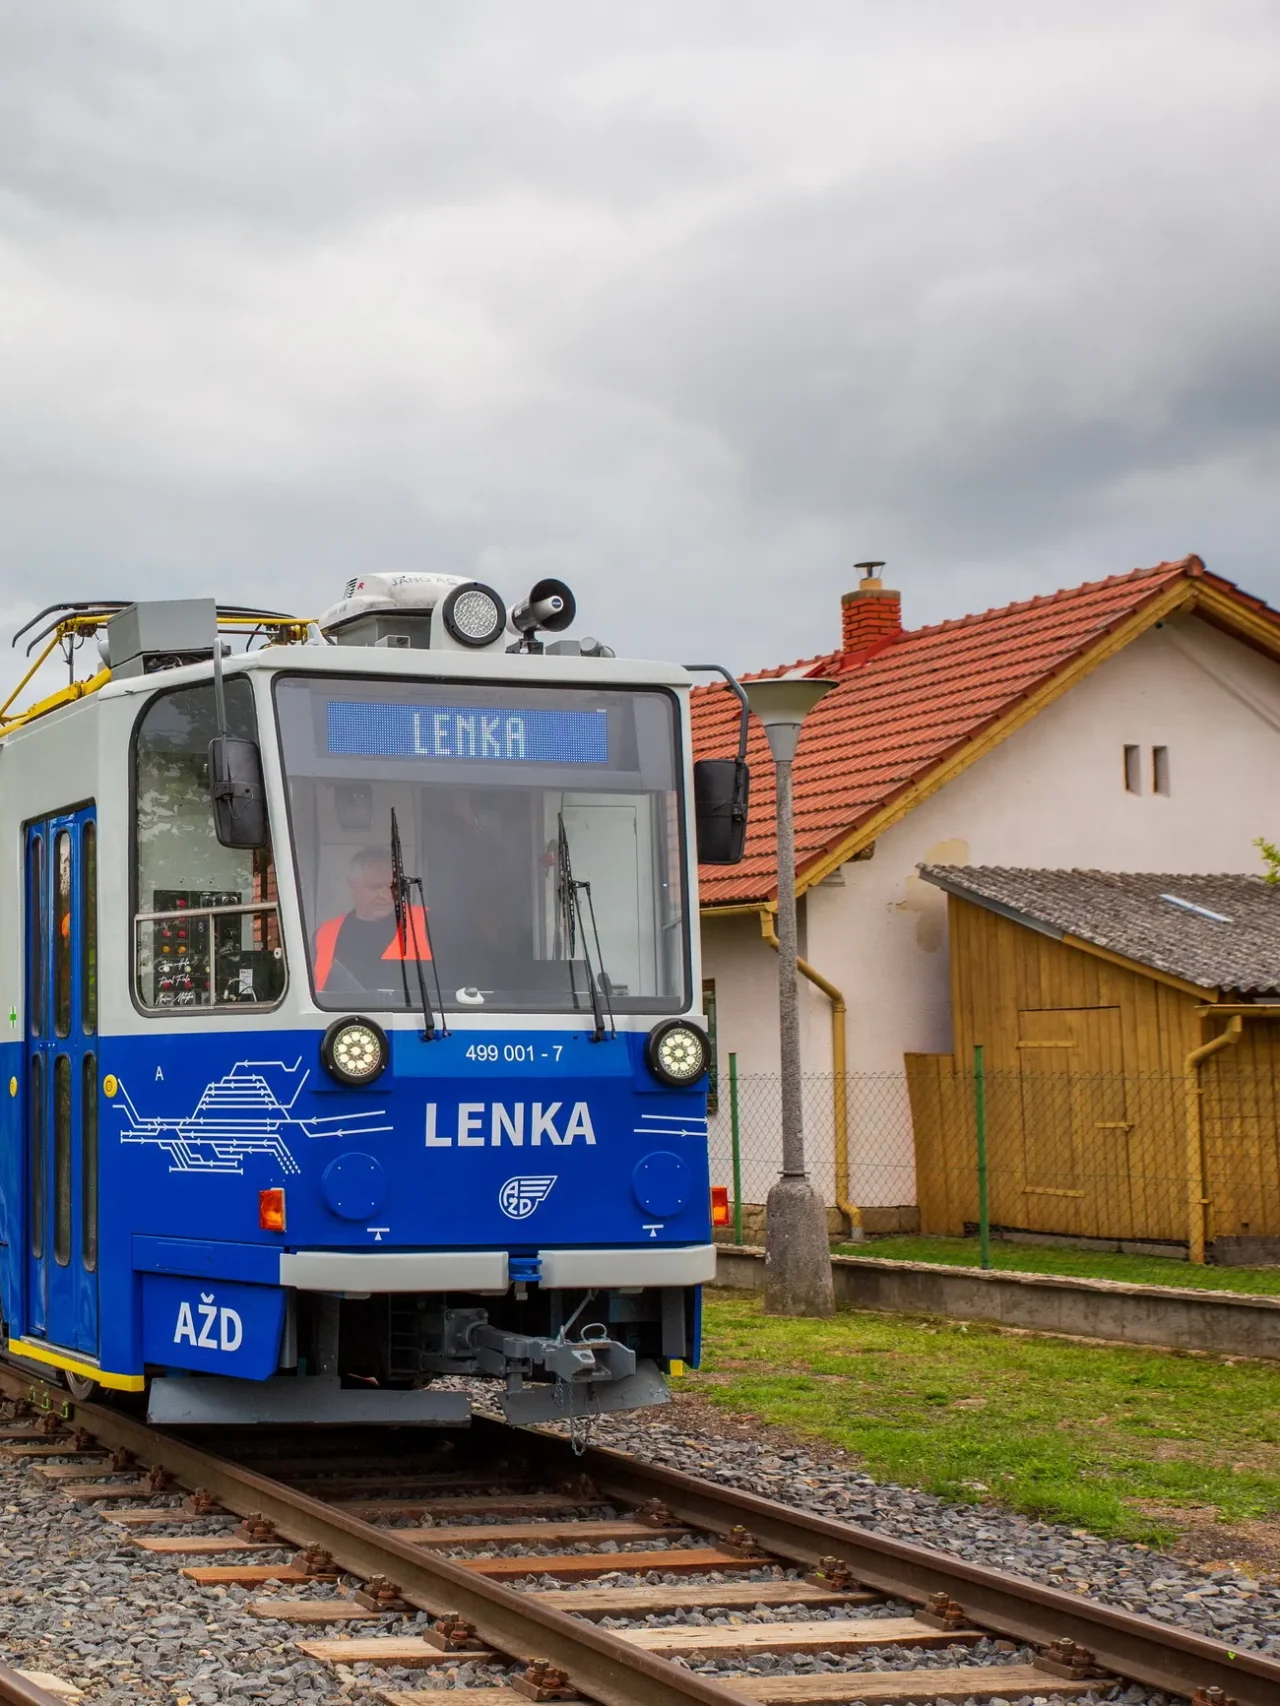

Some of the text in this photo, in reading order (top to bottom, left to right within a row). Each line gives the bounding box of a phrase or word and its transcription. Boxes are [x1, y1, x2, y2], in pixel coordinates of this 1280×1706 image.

[413, 713, 525, 758] LENKA
[155, 1065, 164, 1081] A
[465, 1044, 499, 1062] 499
[425, 1102, 597, 1147] LENKA
[173, 1291, 243, 1352] AŽD
